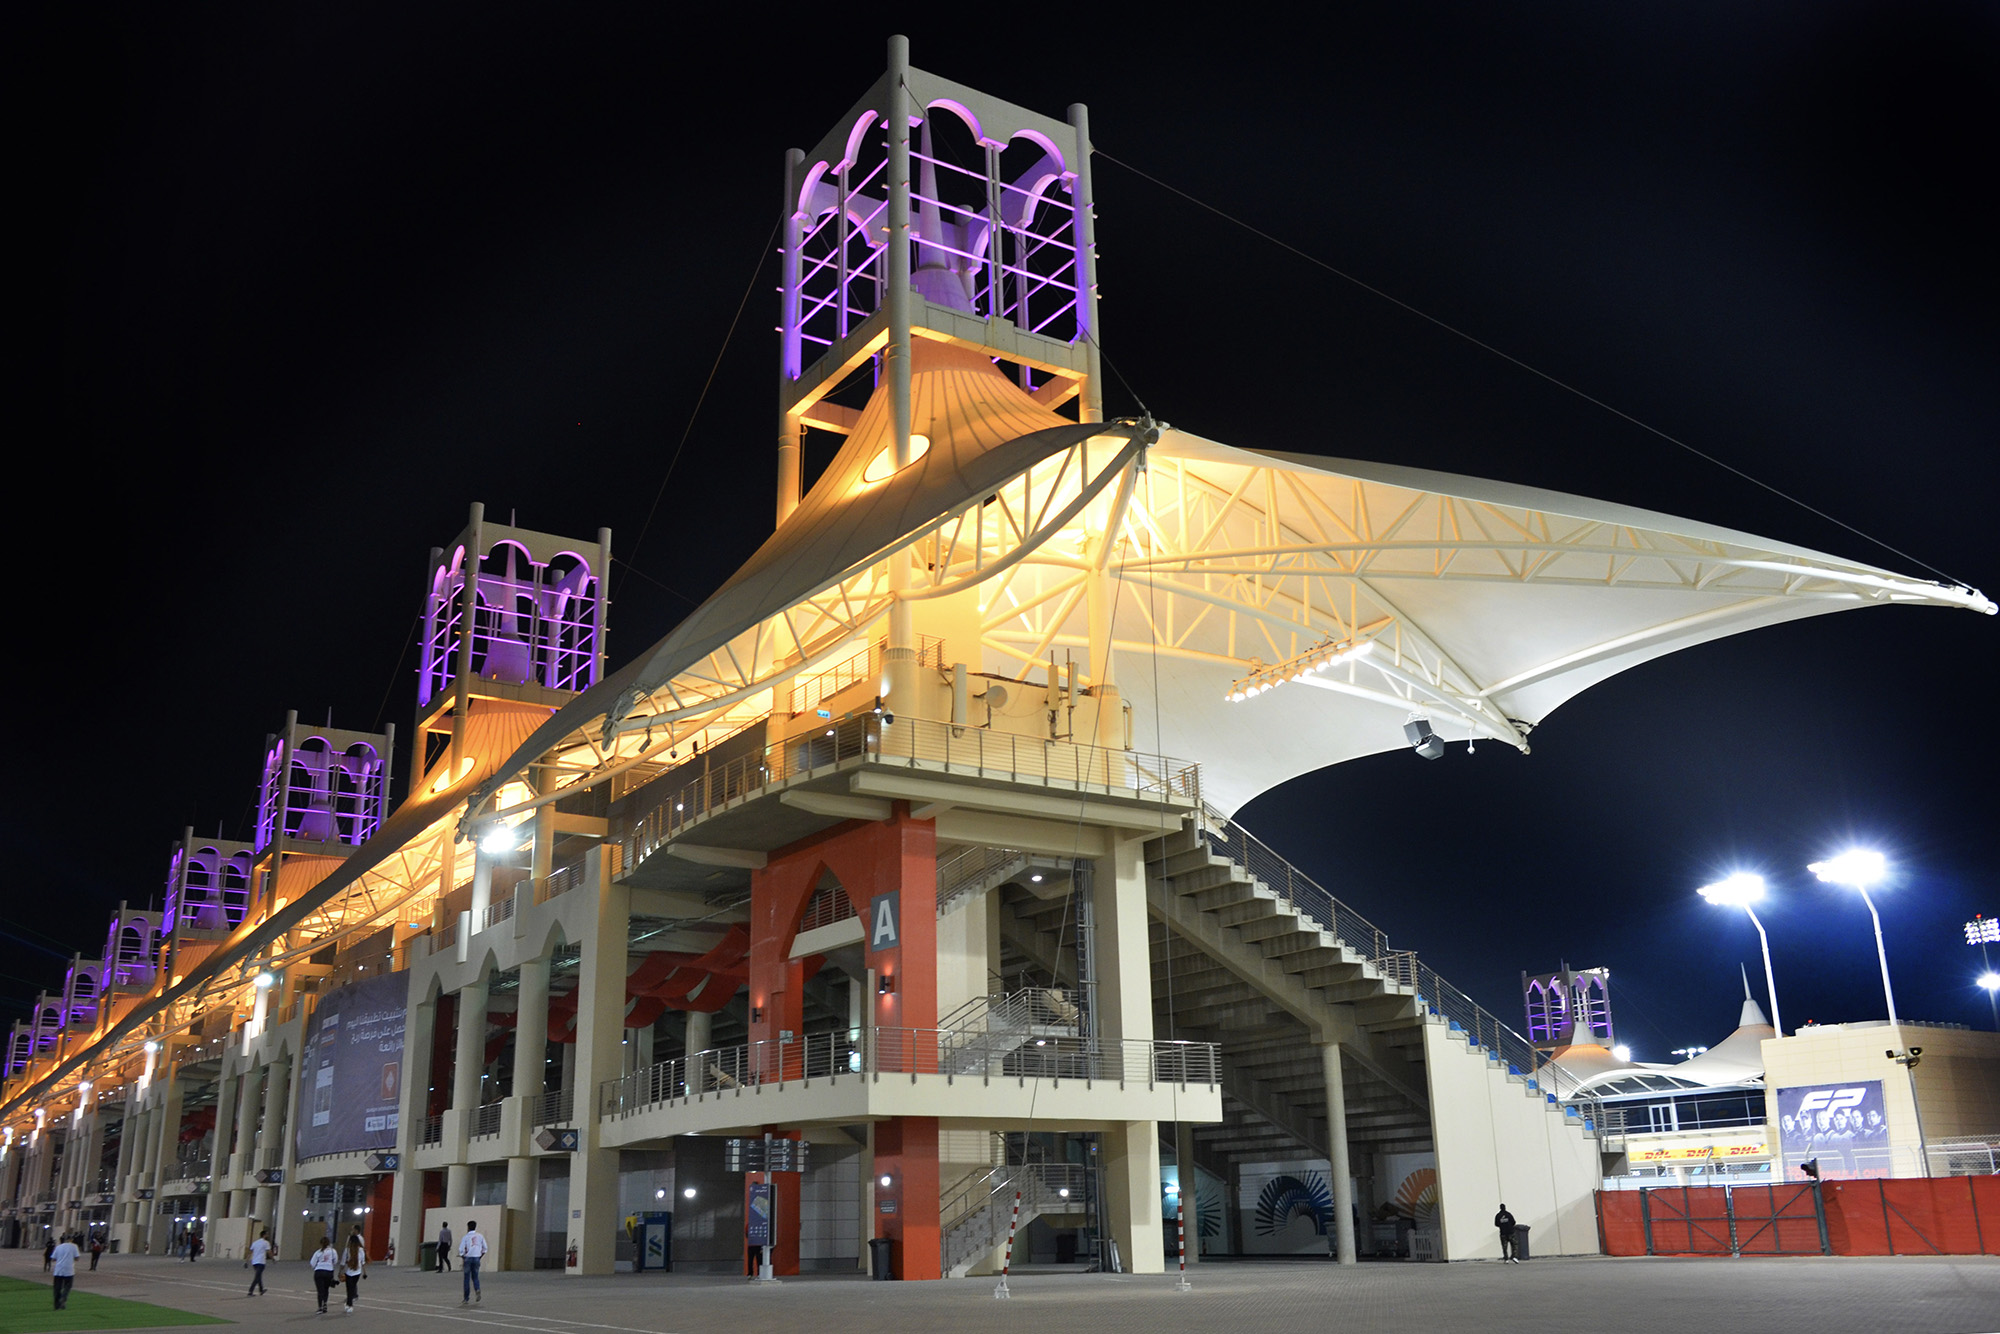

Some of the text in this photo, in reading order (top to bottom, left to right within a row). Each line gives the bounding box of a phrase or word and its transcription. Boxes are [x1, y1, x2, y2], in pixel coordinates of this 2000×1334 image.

[873, 899, 896, 945] A
[1644, 1151, 1672, 1159] DHL
[1730, 1146, 1760, 1155] DHL
